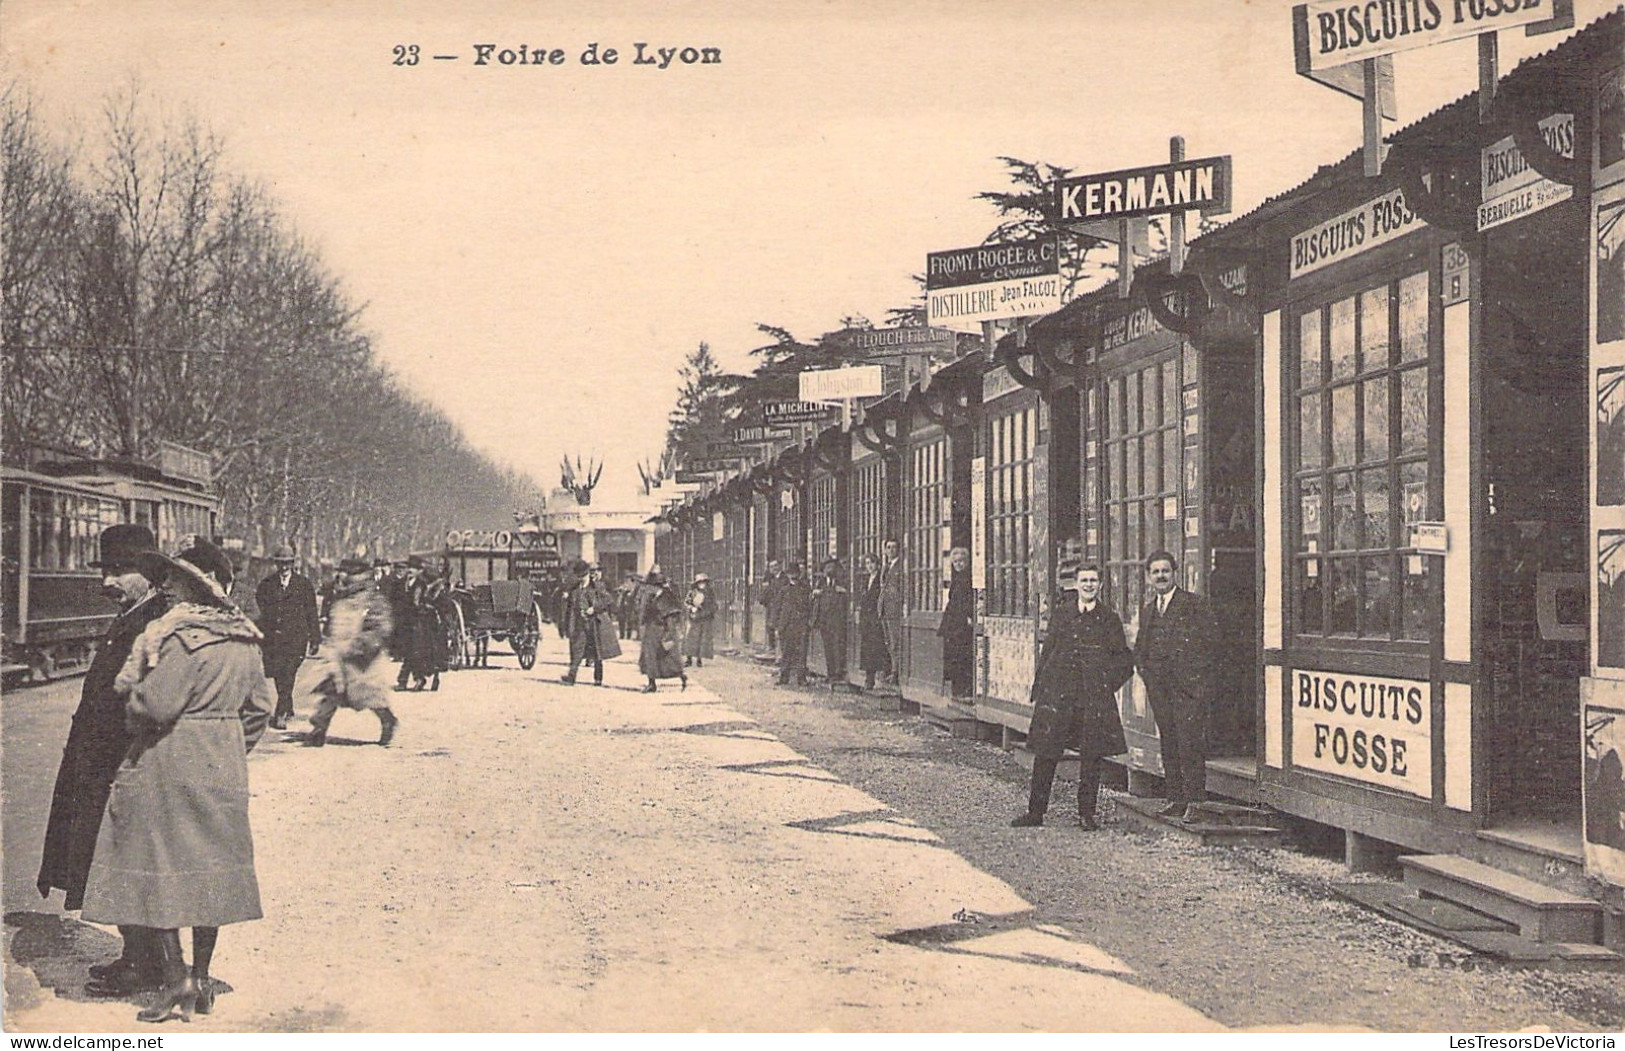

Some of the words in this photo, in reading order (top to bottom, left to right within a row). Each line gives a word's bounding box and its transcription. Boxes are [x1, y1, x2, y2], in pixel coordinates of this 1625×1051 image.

[1487, 147, 1529, 187] BISCUI
[1061, 166, 1213, 219] KERMANN
[1480, 191, 1533, 228] BERRUELLE
[1294, 211, 1366, 271] BISCUITS
[1372, 194, 1420, 239] FOS
[978, 245, 1024, 270] ROGÉE
[1027, 248, 1037, 263] &
[931, 288, 998, 319] DISTILLERIE
[1000, 285, 1021, 303] Jean
[1023, 280, 1057, 298] FALCOZ
[765, 404, 776, 416] LA
[1298, 672, 1422, 725] BISCUITS
[1314, 722, 1407, 777] FOSSE
